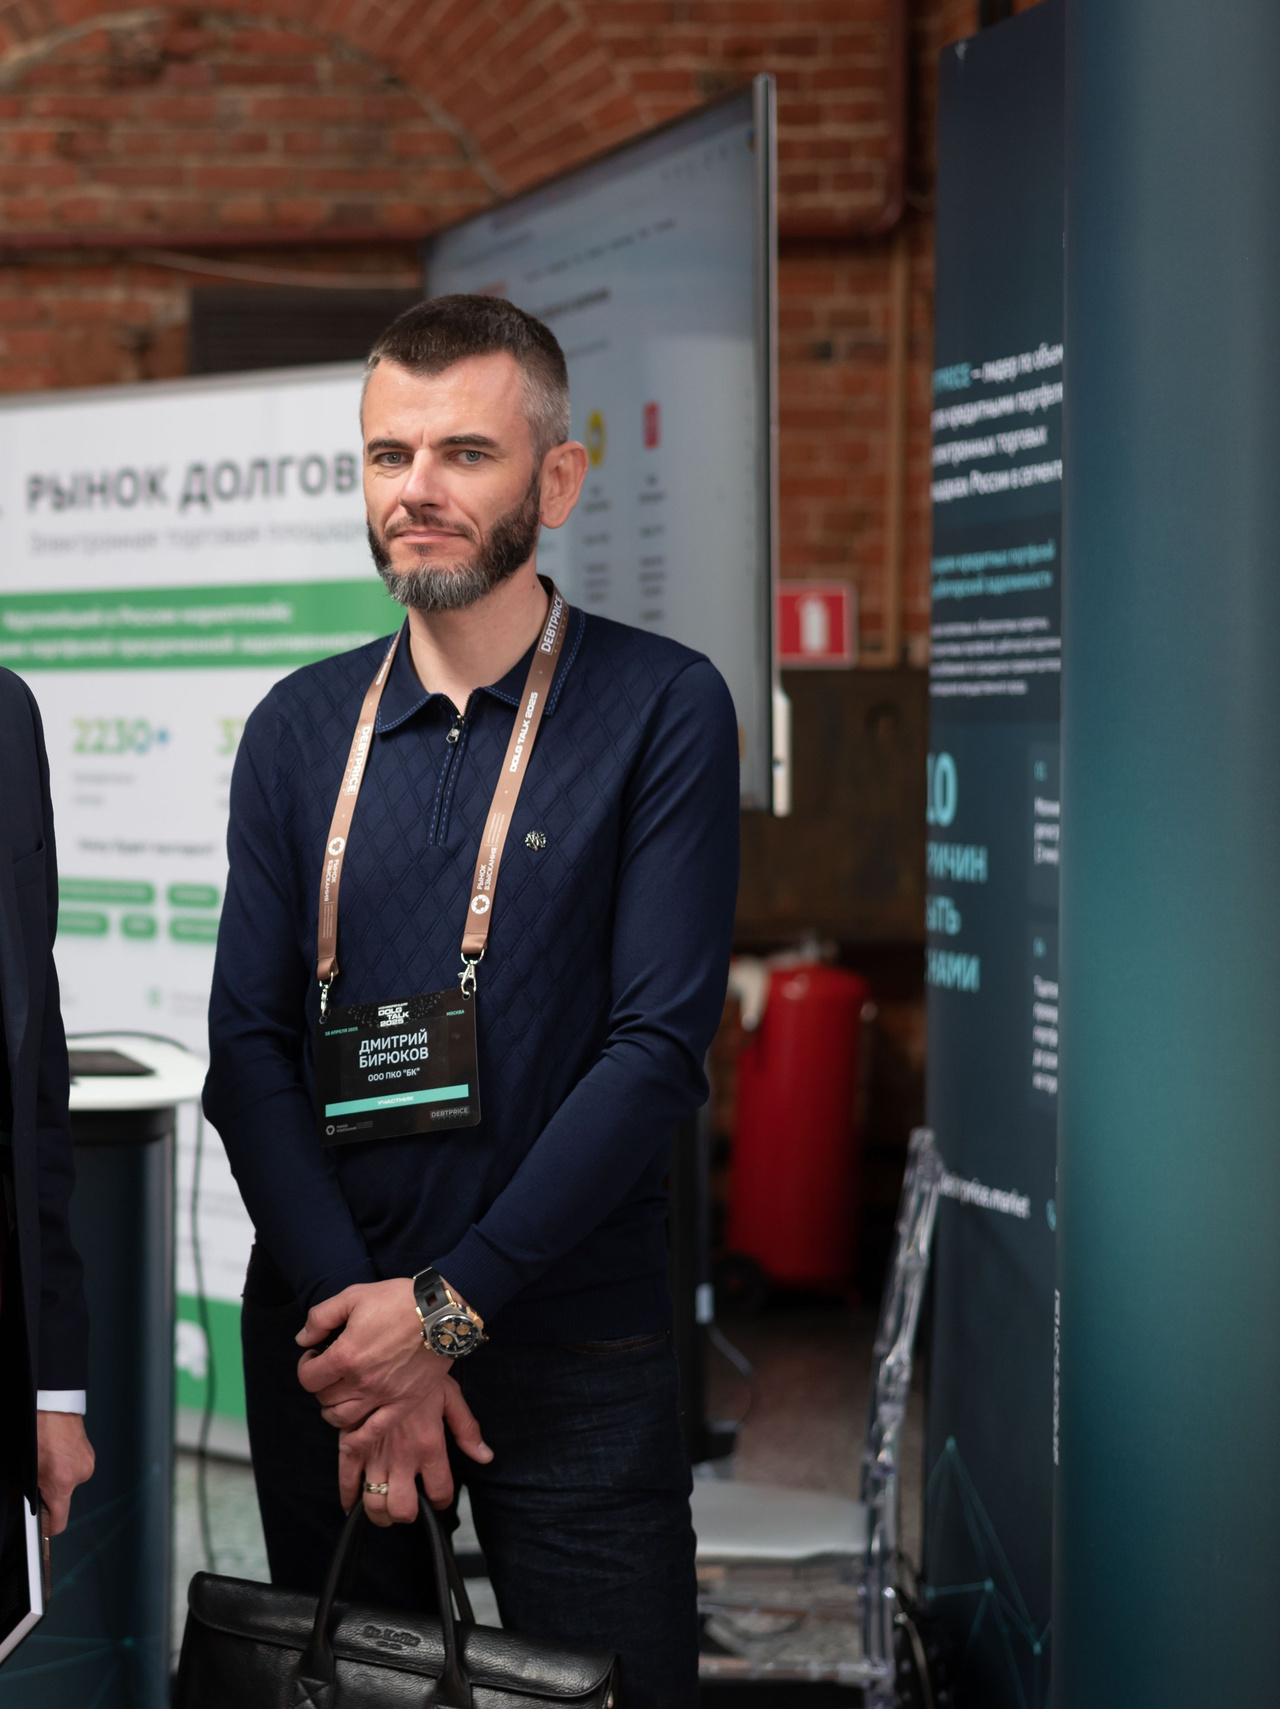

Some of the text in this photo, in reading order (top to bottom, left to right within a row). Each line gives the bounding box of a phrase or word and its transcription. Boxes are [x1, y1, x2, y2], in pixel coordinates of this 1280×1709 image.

[27, 452, 361, 514] РЫНОК ДОЛГОВ
[970, 468, 1010, 496] России
[541, 594, 563, 653] DEBTPRICE
[517, 720, 531, 746] TALK
[525, 692, 538, 719] 2025
[347, 725, 372, 793] DEBTPRICE
[477, 864, 487, 890] РЫНОК
[484, 847, 498, 891] ВЗЫСКАНИЯ
[378, 1006, 403, 1017] DOLG
[380, 1018, 405, 1028] 2025
[386, 1011, 410, 1020] TALK
[446, 1009, 465, 1017] МОСКВА
[359, 1028, 428, 1055] ДМИТРИЙ
[359, 1046, 429, 1069] БИРЮКОВ
[368, 1067, 421, 1082] ООО ПКО "БК"
[377, 1096, 414, 1105] УЧАСТНИК
[431, 1107, 468, 1118] DEBTPRICE
